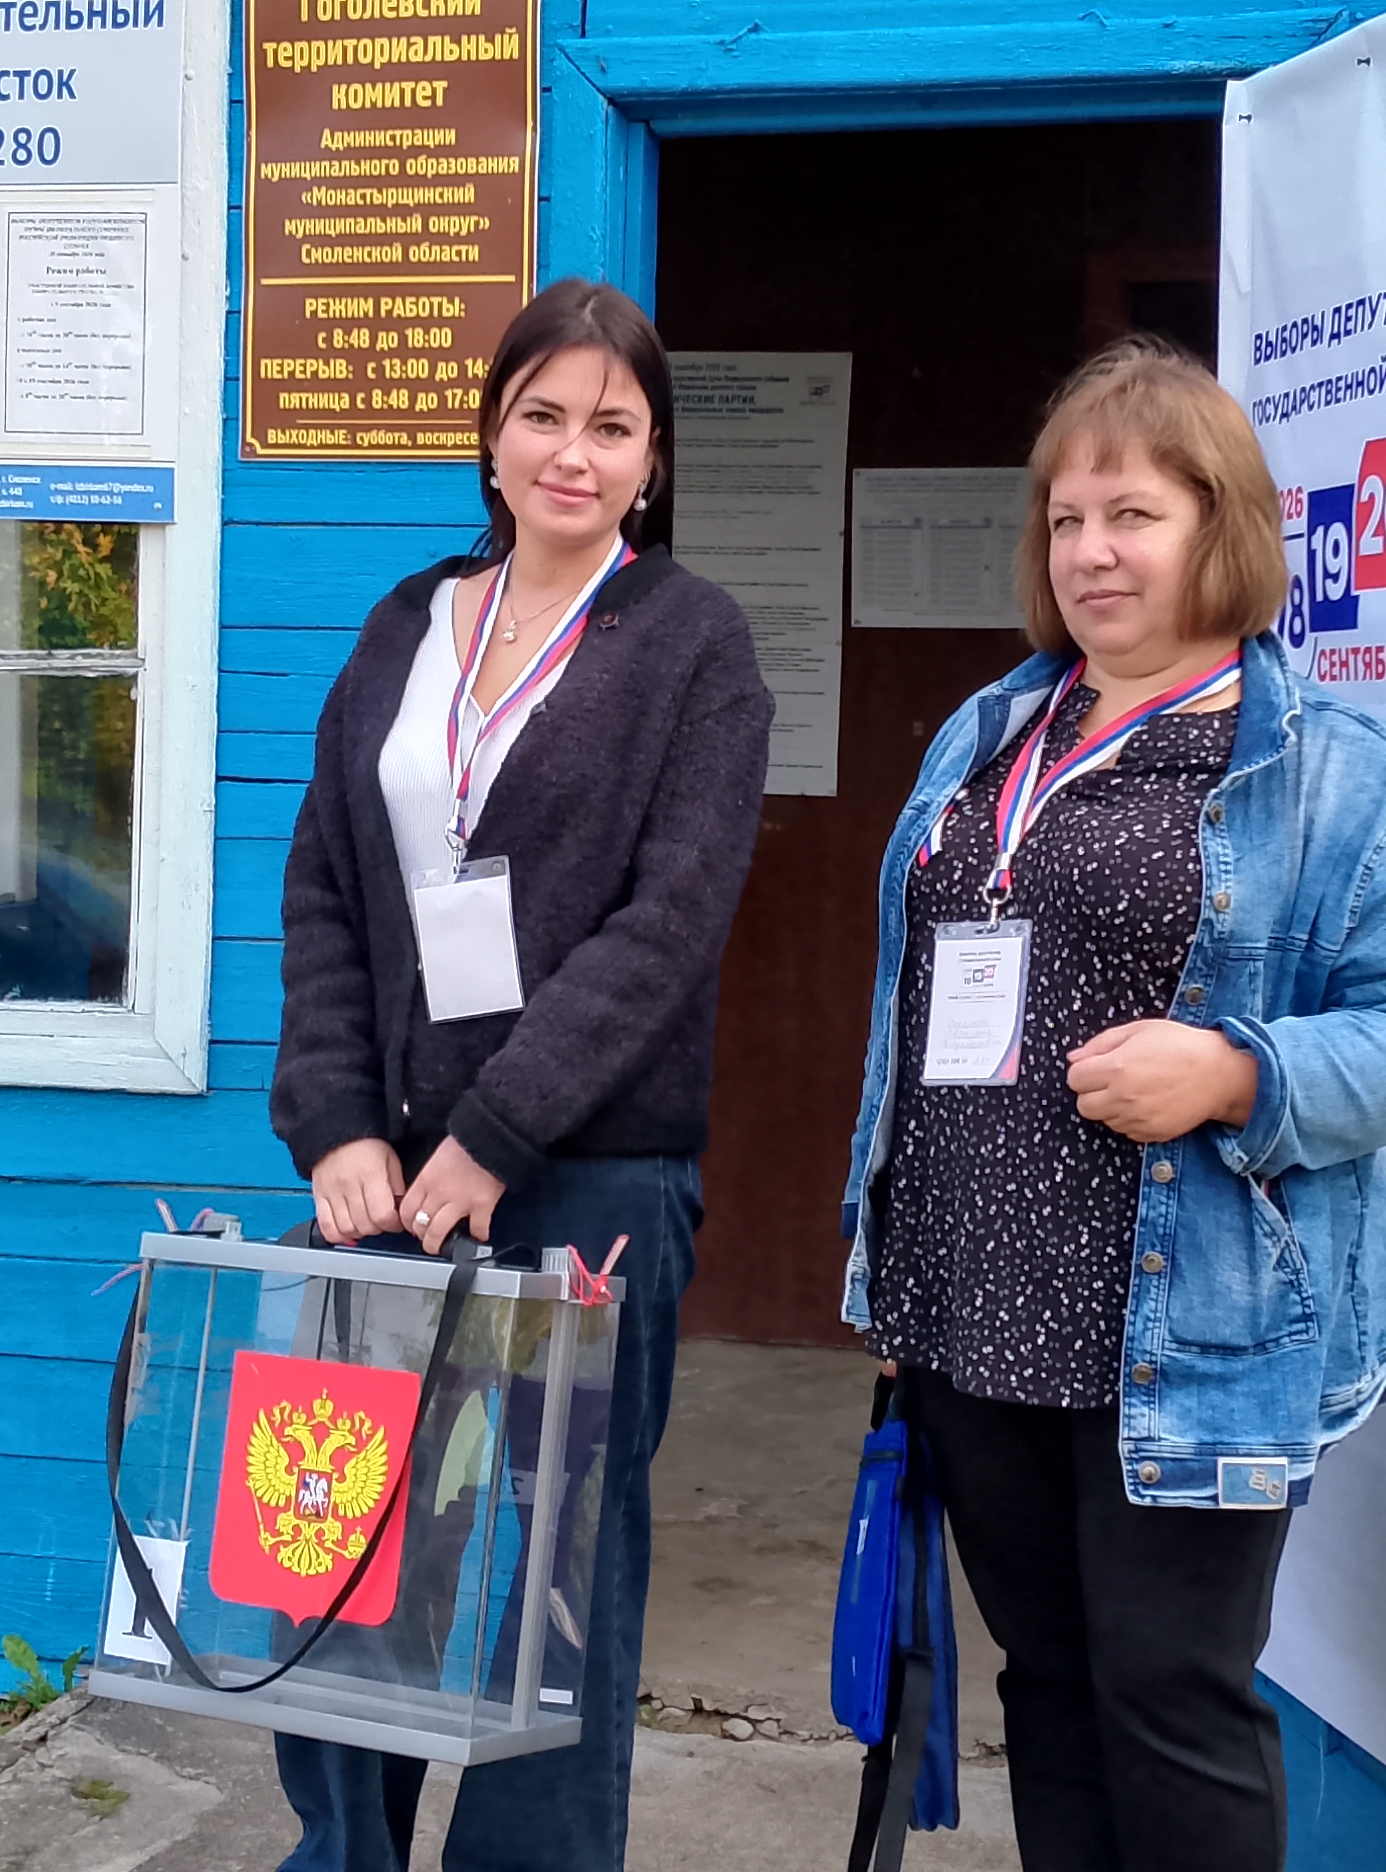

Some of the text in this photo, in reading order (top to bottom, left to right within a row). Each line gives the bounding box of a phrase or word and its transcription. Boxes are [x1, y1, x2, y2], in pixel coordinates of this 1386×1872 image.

[263, 27, 519, 72] территориальный
[332, 80, 447, 109] комитет
[320, 128, 455, 150] Администрации
[261, 155, 519, 182] муниципального образования
[301, 183, 475, 207] «Монастырщинский
[284, 213, 490, 238] муниципальный округ»
[301, 242, 479, 264] Смоленской области
[305, 296, 465, 318] РЕЖИМ РАБОТЫ:
[317, 327, 451, 351] с 8:48 до 18:00
[1253, 310, 1324, 366] ВЫБОРЫ
[261, 358, 491, 381] ПЕРЕРЫВ: с 13:00 до 14:
[279, 388, 481, 411] пятница с 8:48 до 17:0
[267, 429, 479, 448] ВЫХОДНЫЕ: суббота, воскресе
[1280, 485, 1303, 521] 26
[1311, 521, 1348, 602] 19
[1278, 574, 1305, 649] 8
